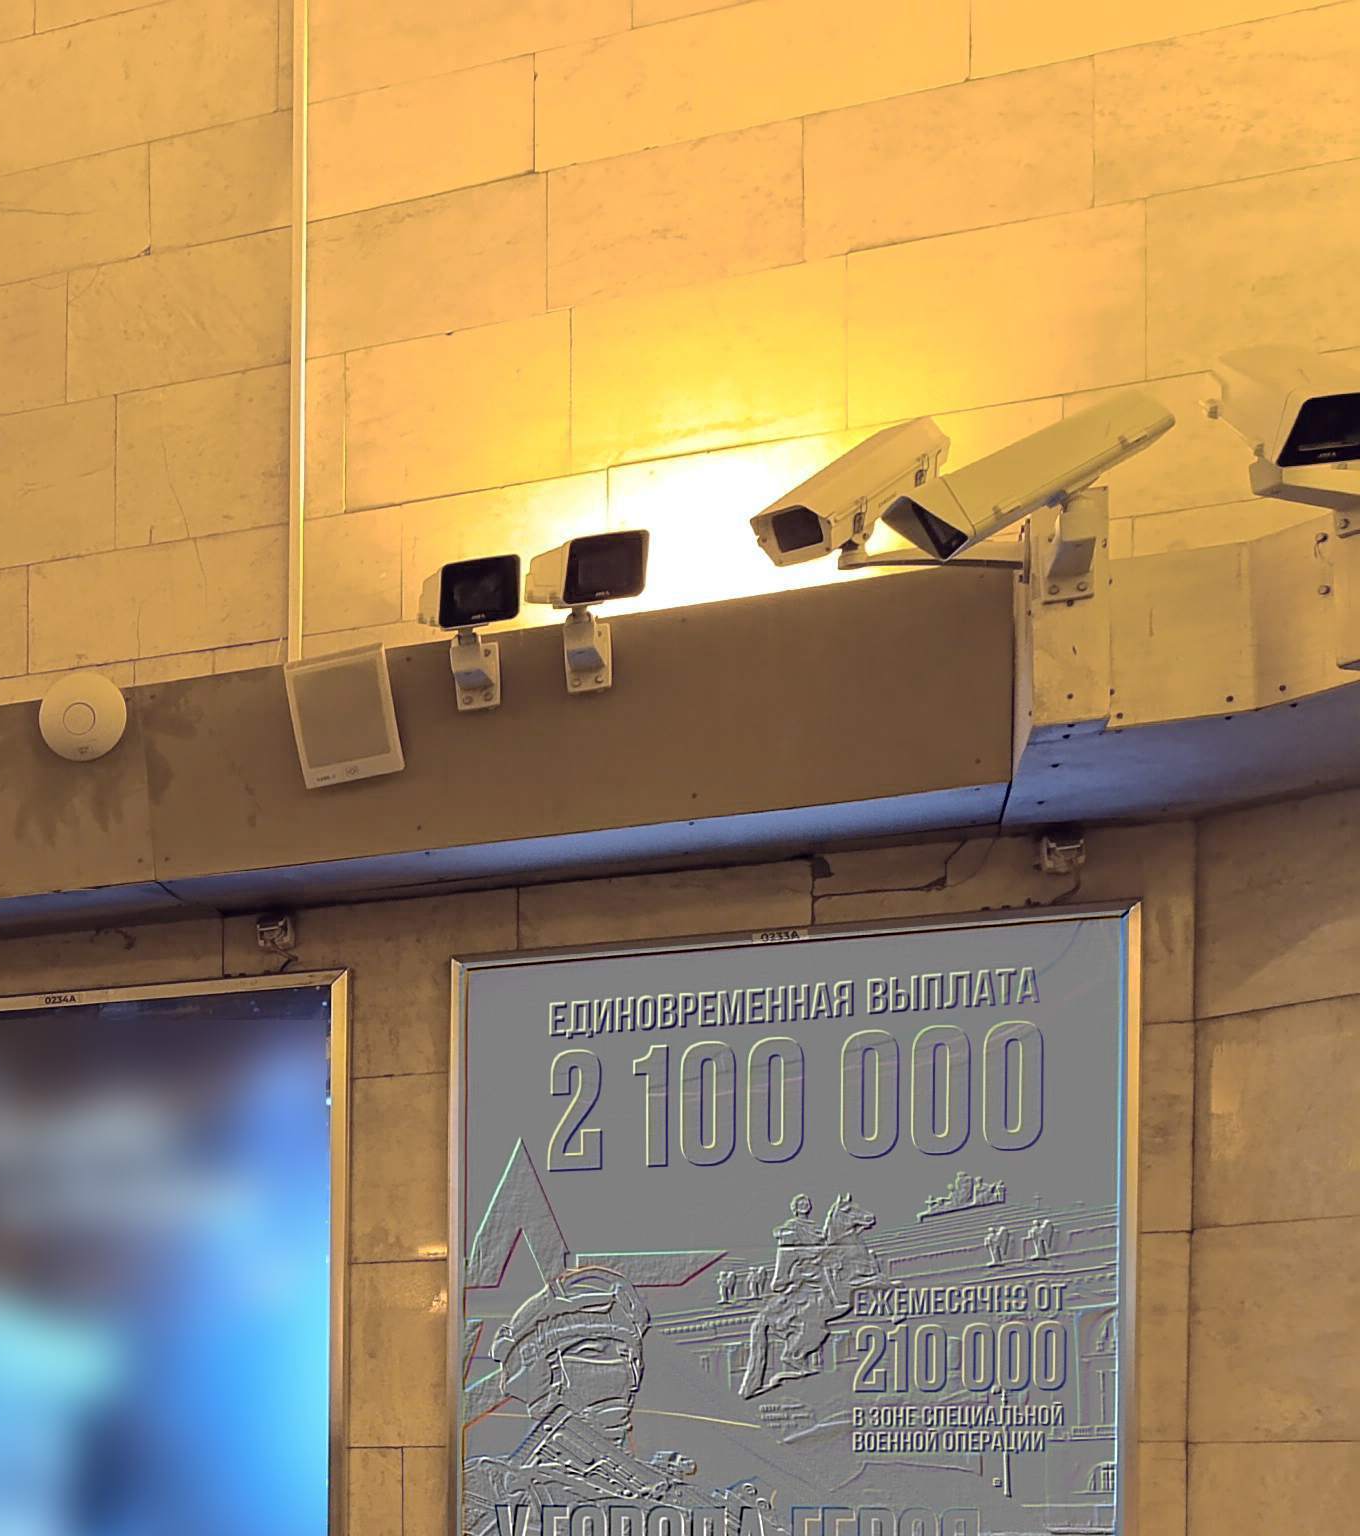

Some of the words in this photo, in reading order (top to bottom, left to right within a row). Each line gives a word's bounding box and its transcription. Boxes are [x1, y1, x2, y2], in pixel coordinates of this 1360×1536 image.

[547, 980, 855, 1040] ЕДИНОВРЕМЕННАЯ
[865, 966, 1041, 1014] ВЫПЛАТА
[547, 1048, 603, 1172] 2
[632, 1036, 805, 1168] 100
[840, 1020, 1045, 1160] 000
[853, 1285, 1029, 1316] ЕЖЕМЕСЯЧНО
[1033, 1284, 1068, 1312] ОТ
[852, 1323, 948, 1394] 210
[961, 1320, 1068, 1393] 000
[852, 1406, 867, 1428] В
[869, 1405, 919, 1428] ЗОНЕ
[922, 1401, 1065, 1430] СПЕЦИАЛЬНОЙ
[852, 1429, 939, 1452] ВОЕННОЙ
[942, 1430, 1046, 1455] ОПЕРАЦИИ
